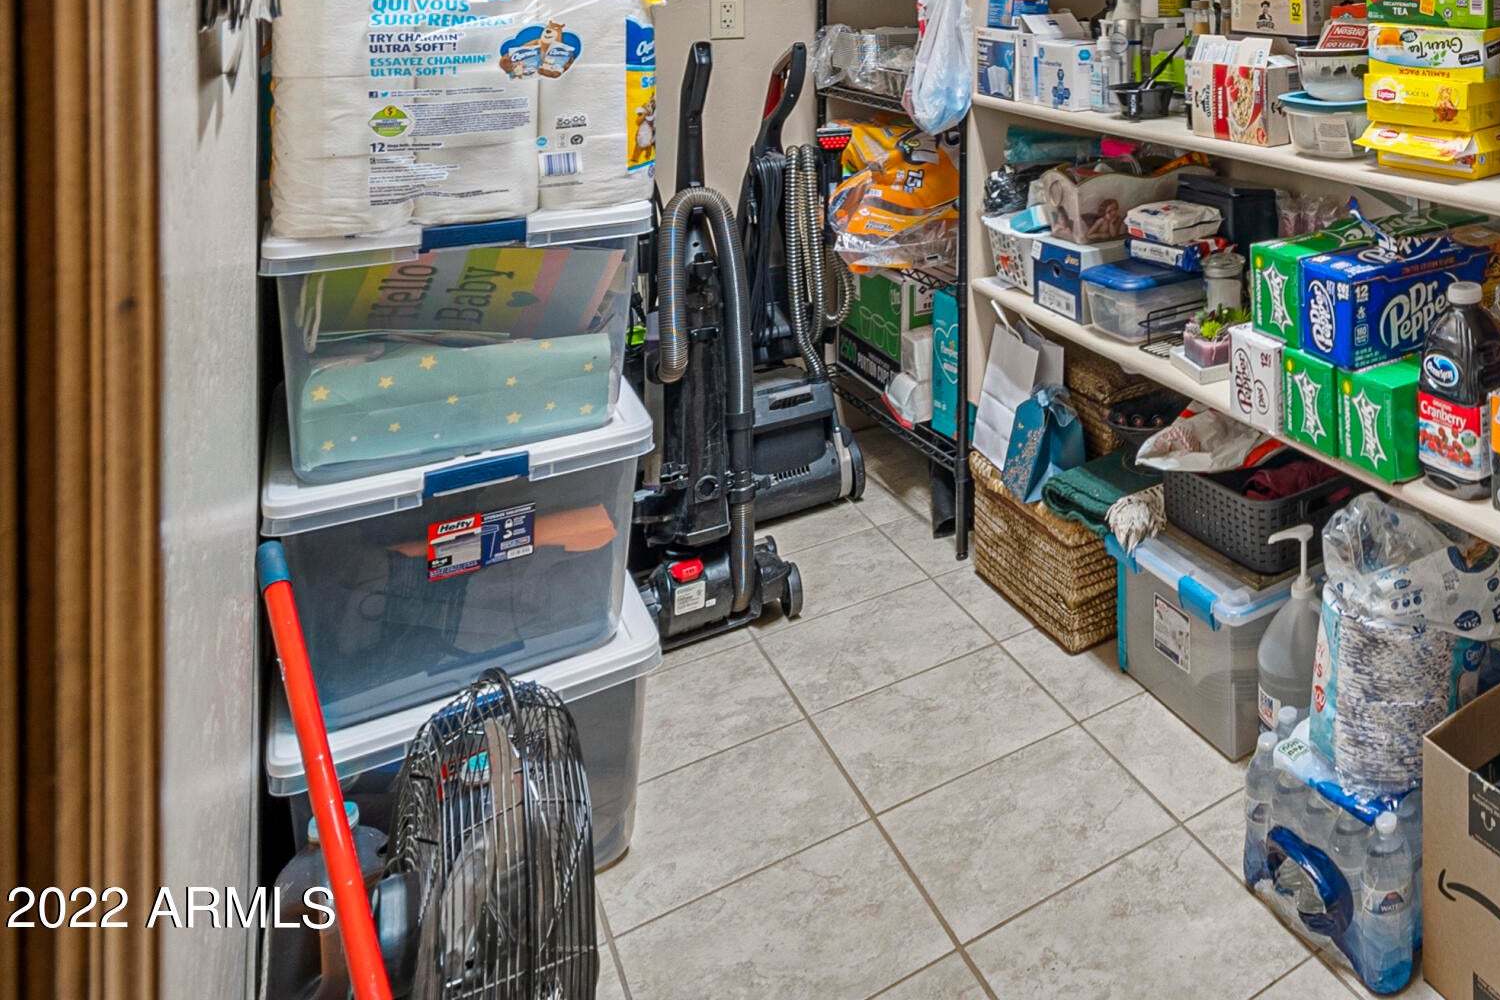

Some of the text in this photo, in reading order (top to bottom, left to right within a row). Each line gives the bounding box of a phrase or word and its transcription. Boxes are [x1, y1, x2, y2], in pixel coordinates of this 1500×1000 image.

[415, 0, 469, 12] VOUS
[1292, 3, 1301, 17] 52
[1392, 6, 1409, 16] TEA
[369, 34, 393, 42] TRY
[369, 45, 411, 53] ULTRA
[1408, 36, 1463, 59] Green Tea
[370, 58, 423, 67] ESSAYEZ
[370, 68, 411, 77] ULTRA
[1419, 69, 1450, 78] FAMILY
[370, 264, 439, 321] Hello
[434, 265, 515, 325] Baby
[1409, 281, 1438, 309] Dr
[1420, 402, 1466, 432] Cranberry
[437, 517, 475, 534] Hefty
